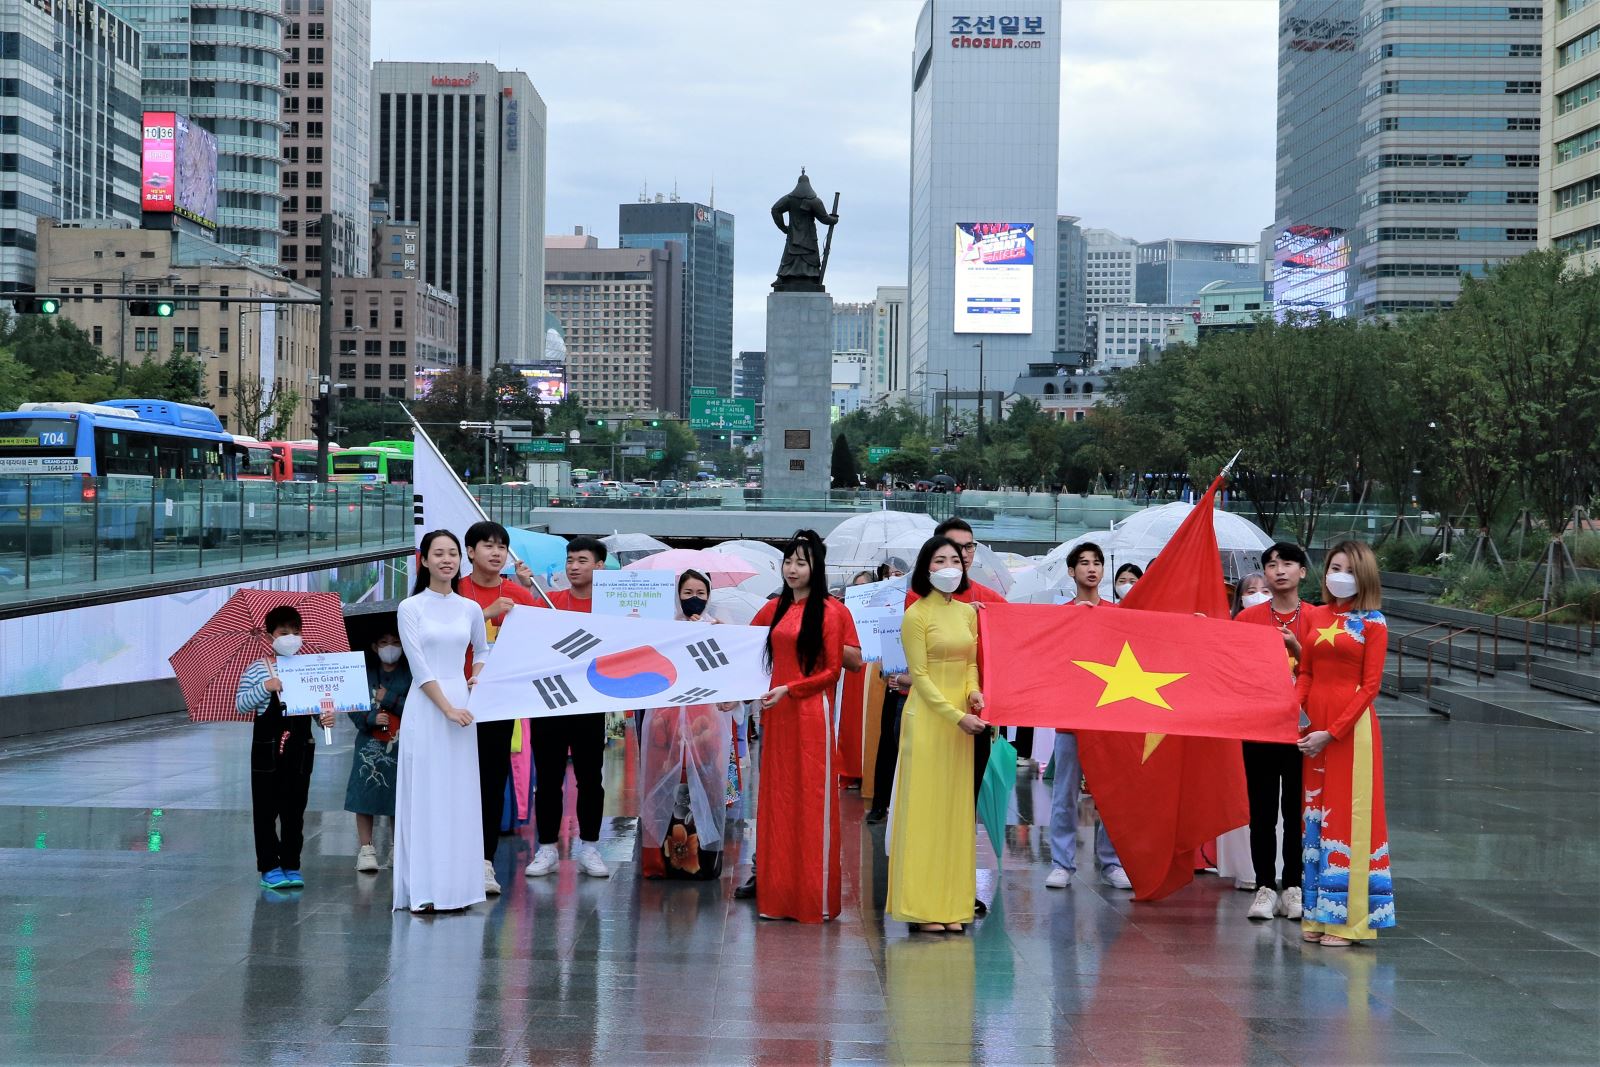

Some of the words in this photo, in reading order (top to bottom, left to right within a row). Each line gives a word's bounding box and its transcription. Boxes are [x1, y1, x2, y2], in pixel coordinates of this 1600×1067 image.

[949, 15, 1046, 35] 조선일보
[951, 35, 1041, 48] chosun.com
[432, 75, 471, 87] kobaco
[42, 432, 64, 444] 704
[321, 675, 344, 683] Giang
